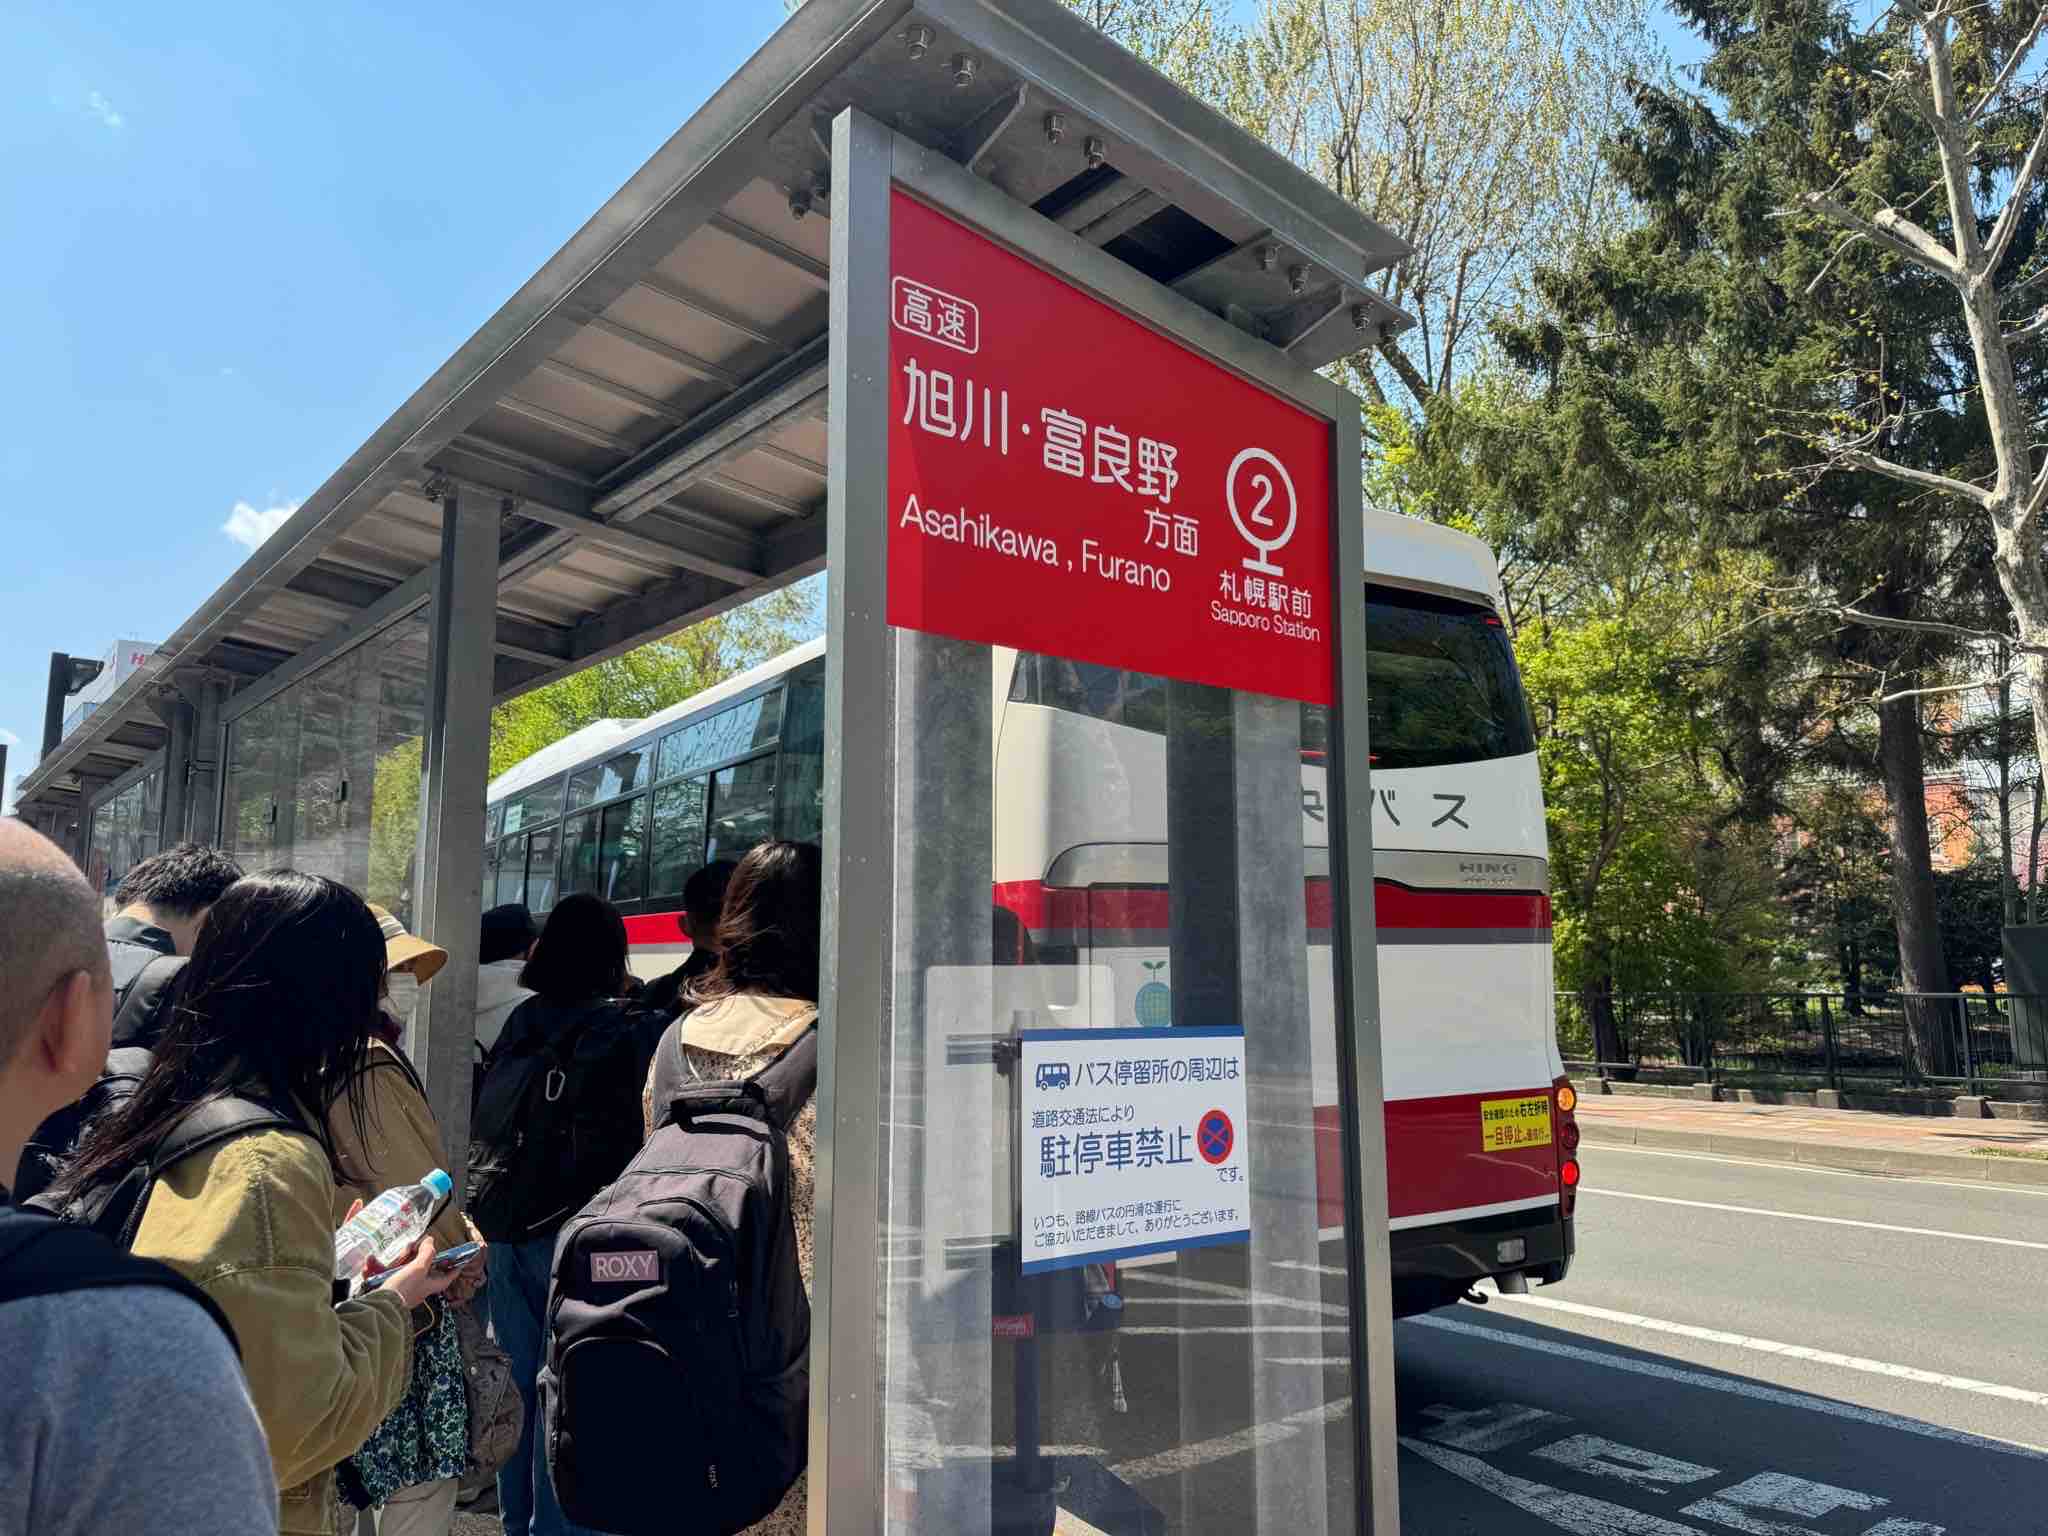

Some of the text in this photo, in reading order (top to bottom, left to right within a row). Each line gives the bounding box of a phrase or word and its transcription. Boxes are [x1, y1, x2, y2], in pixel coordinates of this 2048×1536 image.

[902, 286, 967, 346] 高速
[902, 358, 1180, 505] 旭川・富良野
[1251, 473, 1274, 527] 2
[1143, 507, 1200, 557] 方面
[1082, 539, 1171, 593] Furano
[1219, 569, 1313, 619] 札幌駅前
[1210, 599, 1321, 642] Sapporo Station
[1074, 1056, 1241, 1086] バス停留所の周辺は
[1031, 1104, 1135, 1129] 道路交通法により
[1040, 1126, 1193, 1178] 駐停車禁止
[1216, 1166, 1244, 1182] です。
[596, 1254, 653, 1278] ROXY
